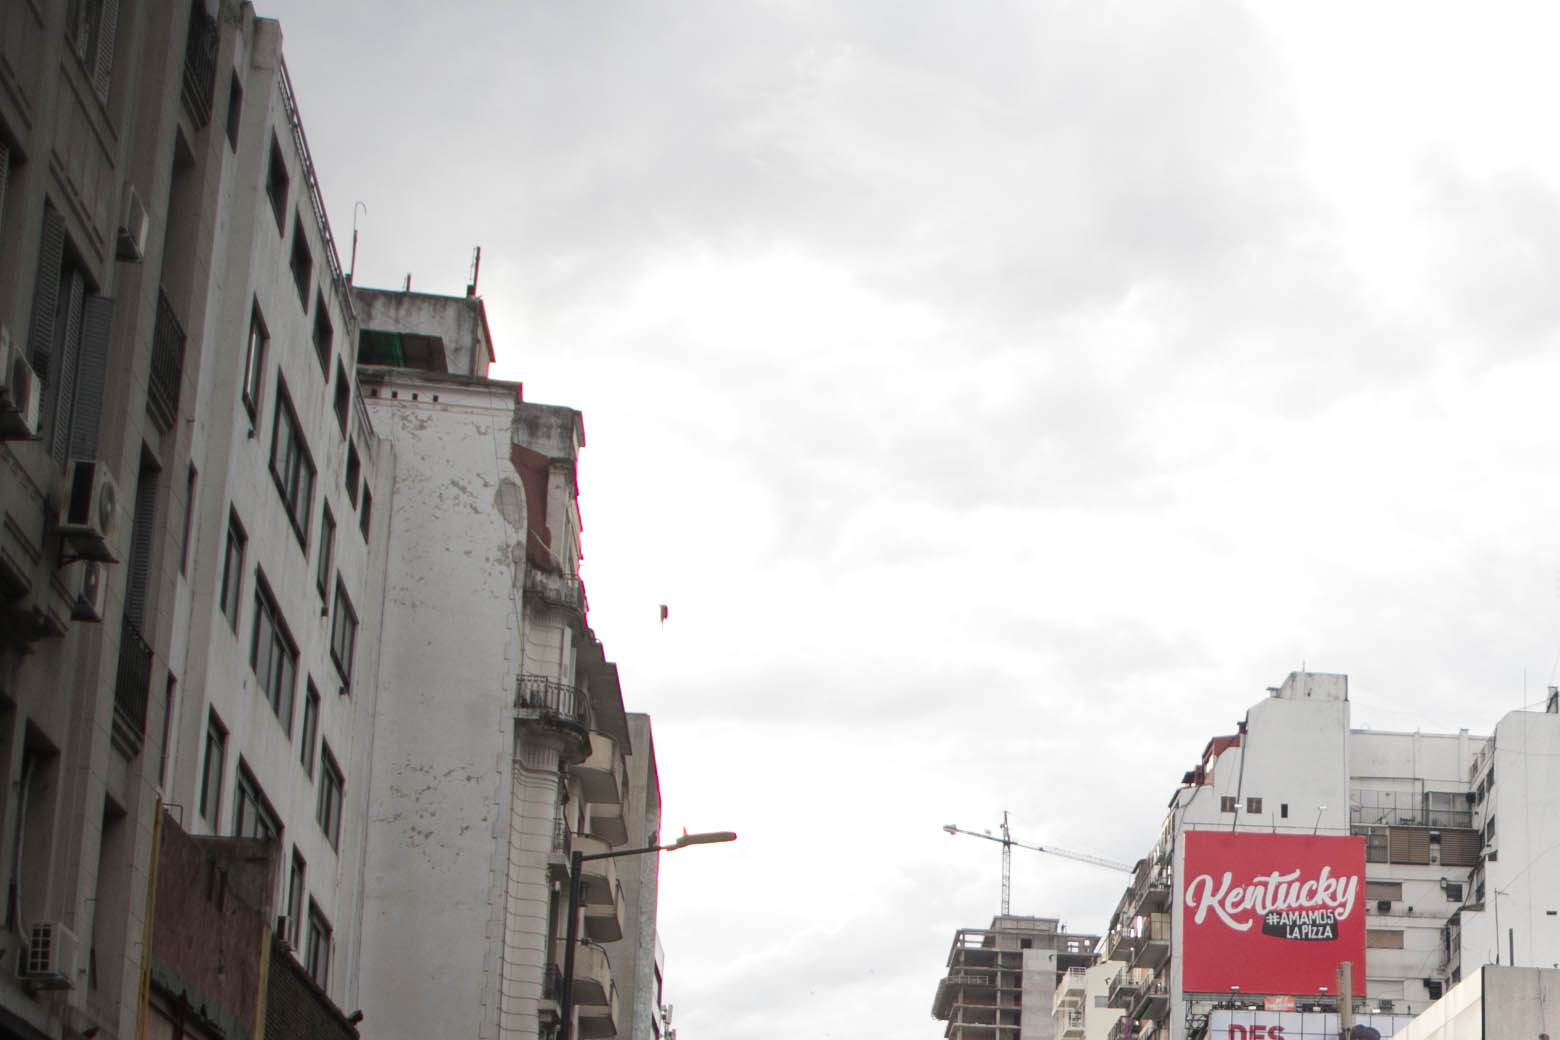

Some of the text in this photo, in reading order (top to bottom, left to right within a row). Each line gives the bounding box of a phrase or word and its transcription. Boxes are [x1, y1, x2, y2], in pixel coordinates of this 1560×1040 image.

[1185, 865, 1358, 931] Kentucky
[1266, 910, 1334, 926] #AMAMOS
[1286, 925, 1333, 939] LA PIZZA
